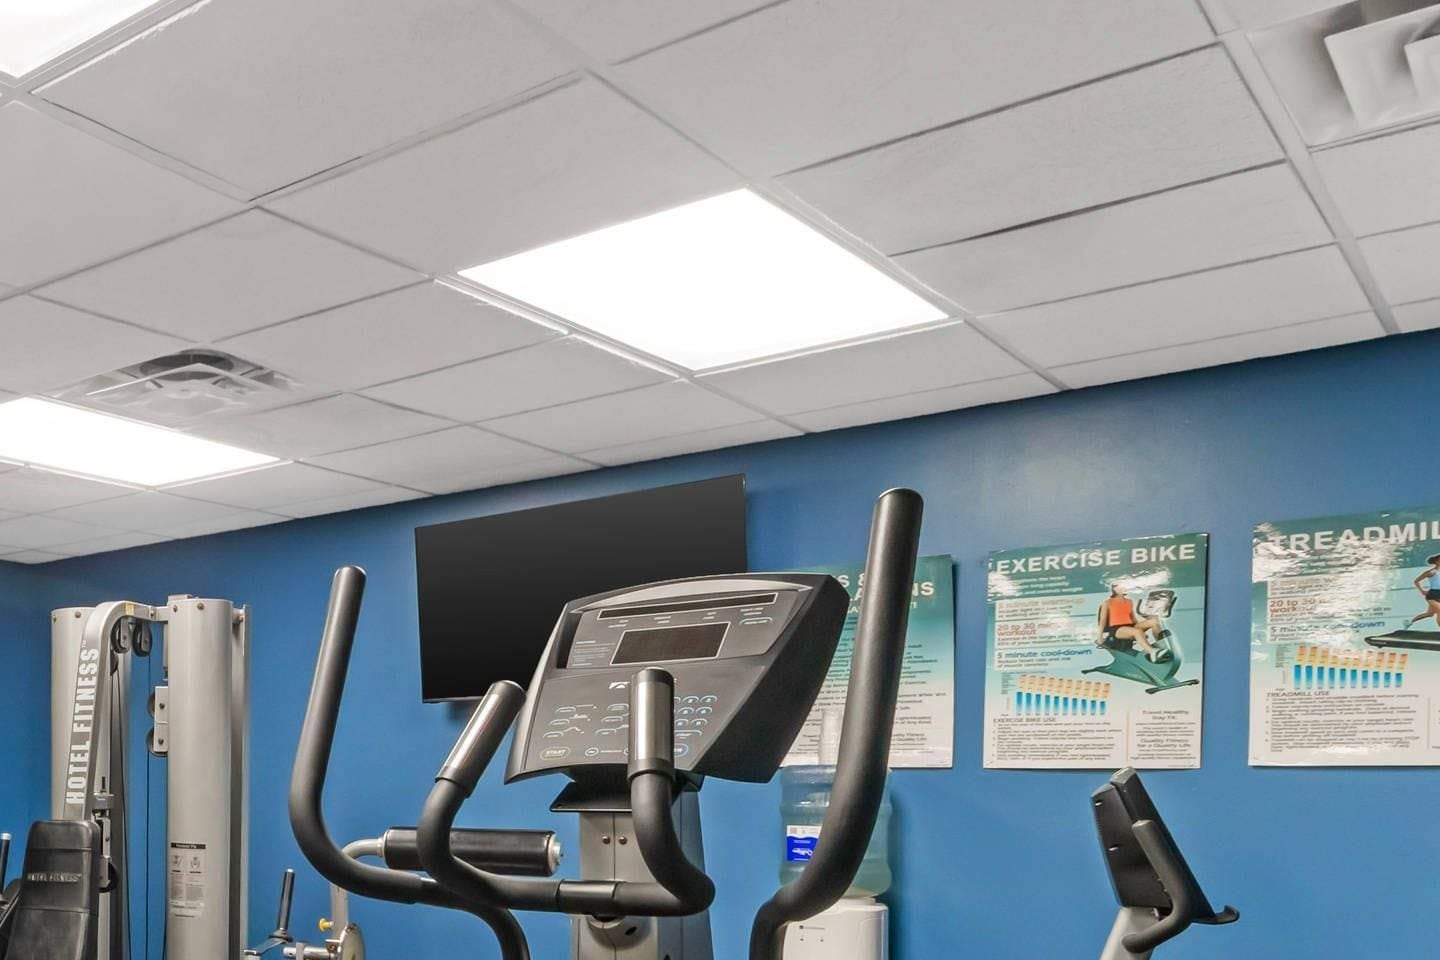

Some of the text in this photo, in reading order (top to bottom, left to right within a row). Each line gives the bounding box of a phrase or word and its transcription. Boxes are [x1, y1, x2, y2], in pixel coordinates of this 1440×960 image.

[997, 543, 1196, 575] EXERCISE BIKE
[1269, 599, 1283, 607] 20
[1040, 647, 1093, 657] cool-down
[66, 648, 99, 804] HOTEL FITNESS
